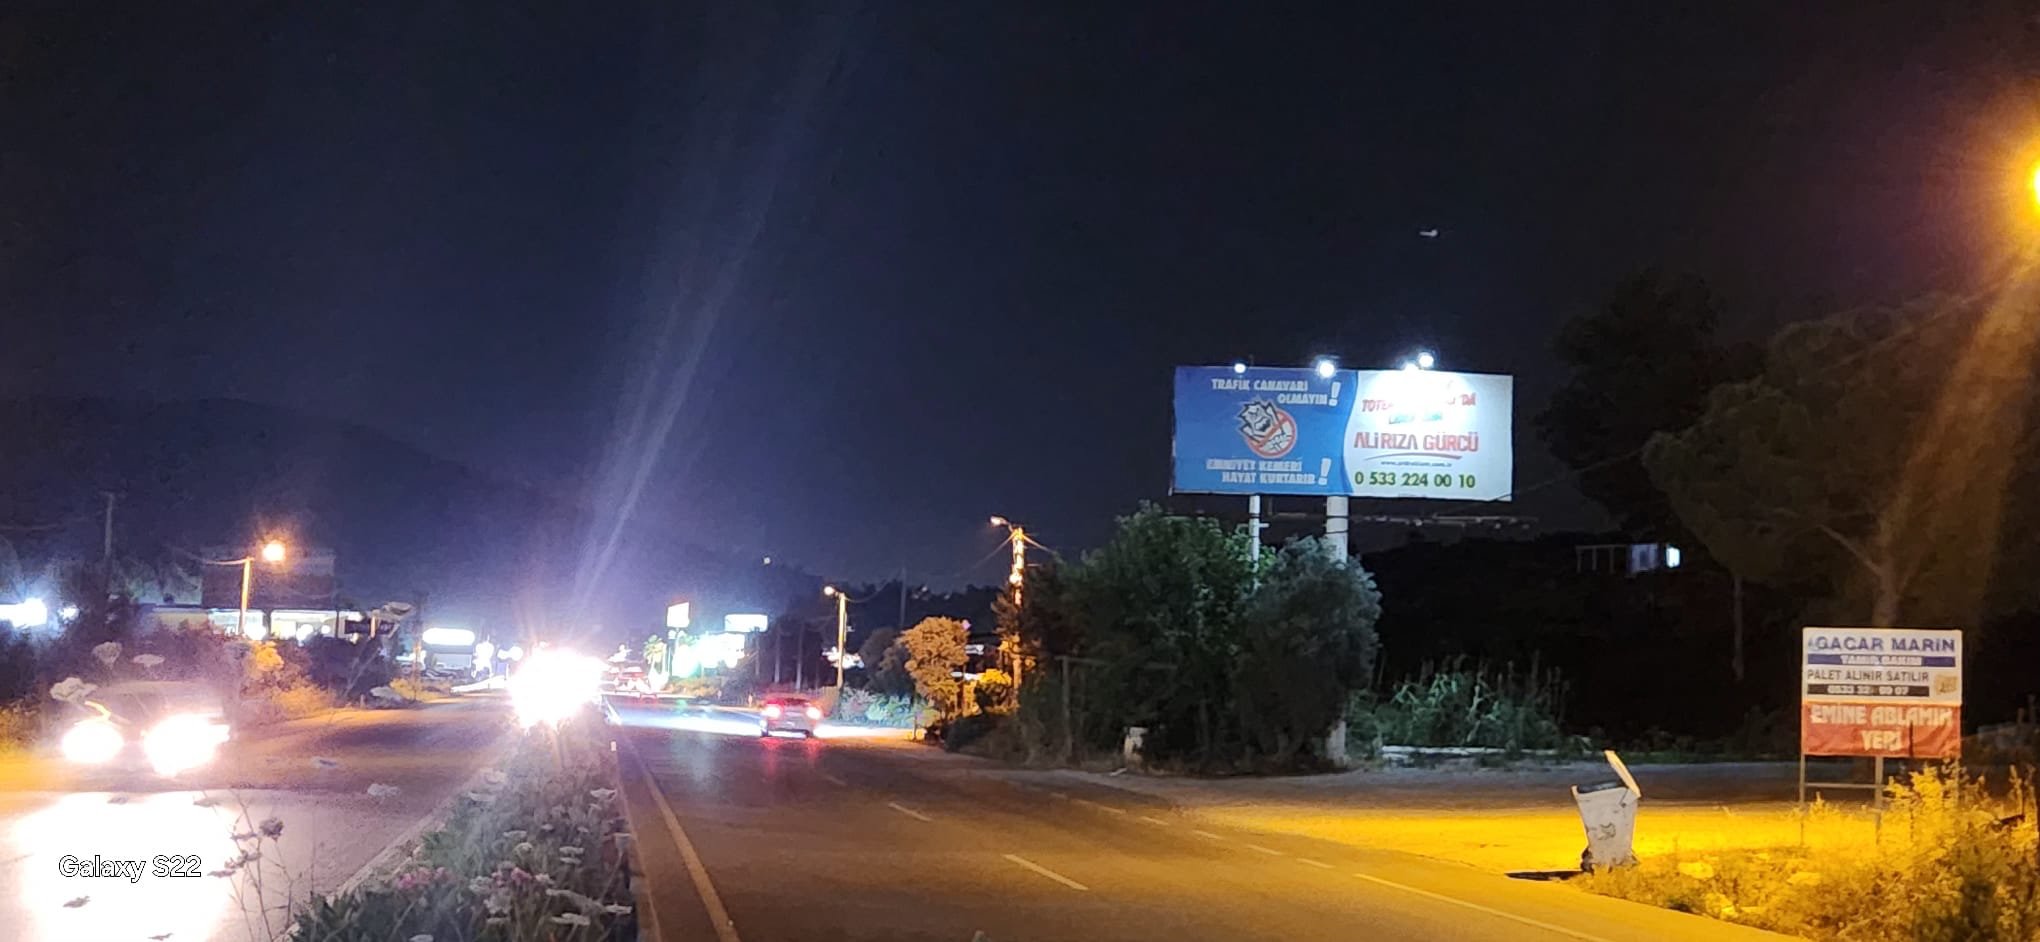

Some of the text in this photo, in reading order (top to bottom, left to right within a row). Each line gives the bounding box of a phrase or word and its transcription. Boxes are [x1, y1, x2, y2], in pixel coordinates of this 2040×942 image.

[1380, 433, 1418, 450] RIZA
[1423, 431, 1479, 452] GÜRCÜ
[1222, 472, 1256, 484] HAYAT
[1354, 471, 1476, 489] 0 533 224 00 10
[1807, 669, 1929, 683] PALET ALINIR SATILIR
